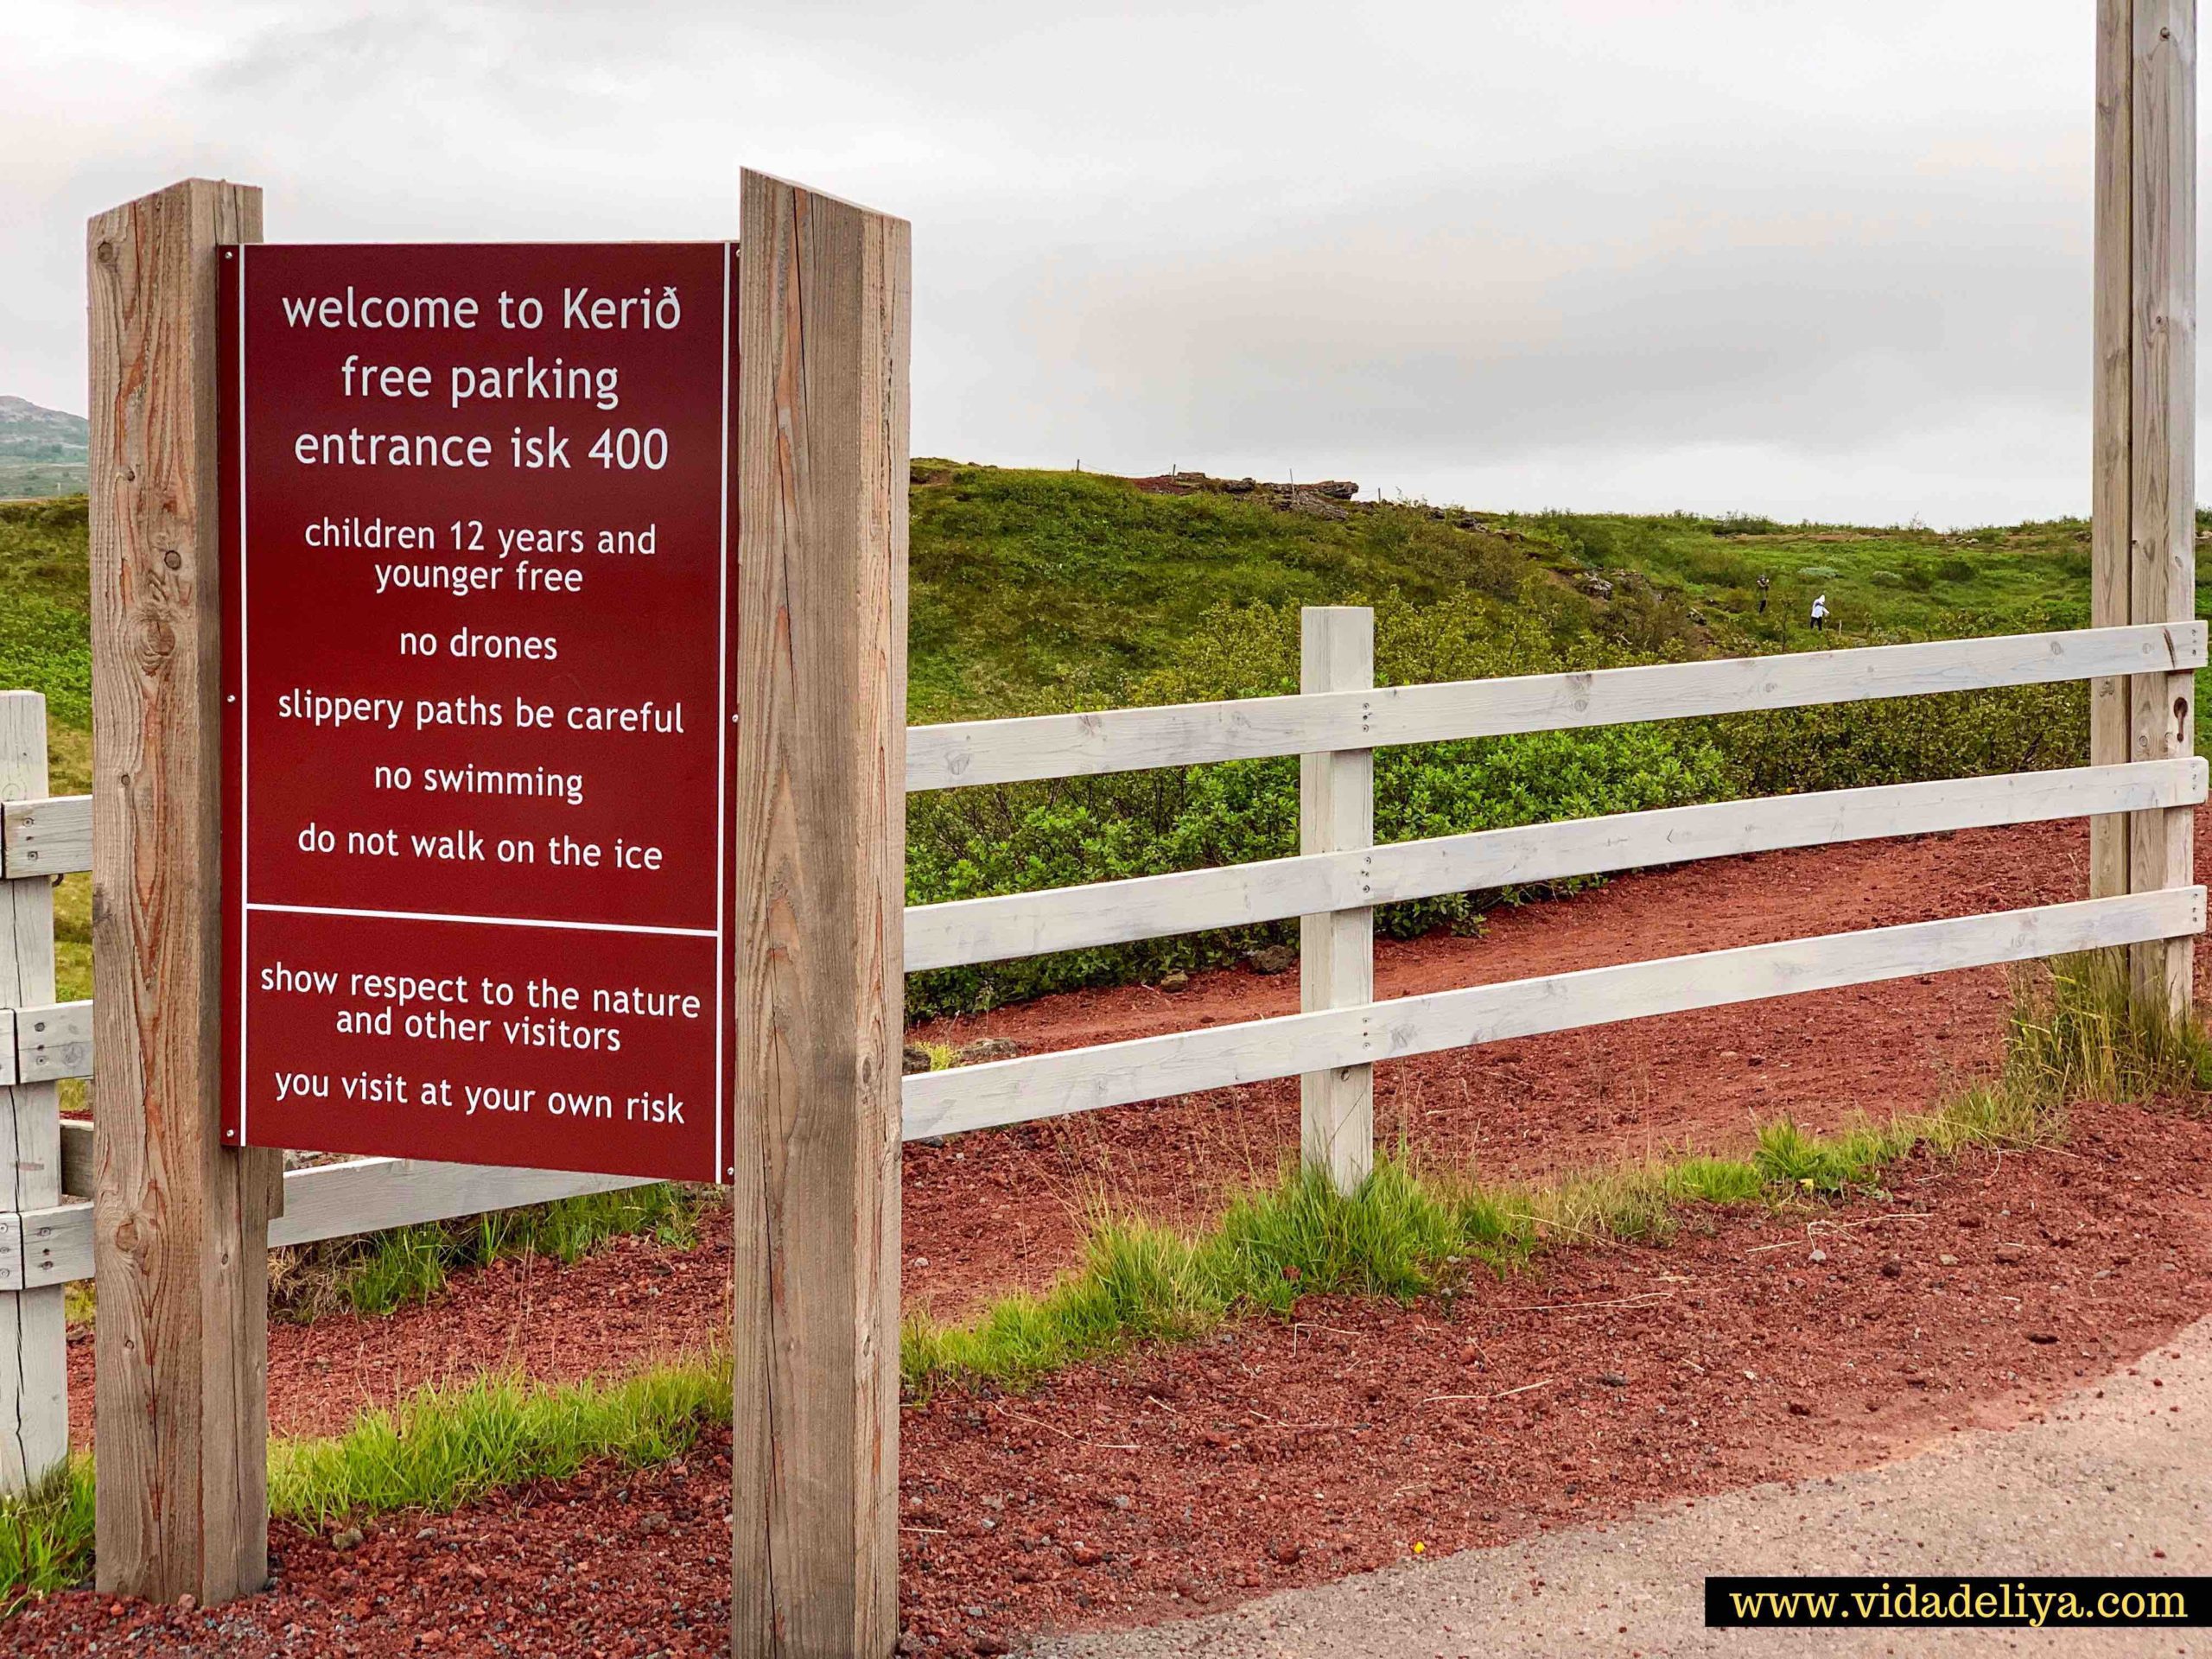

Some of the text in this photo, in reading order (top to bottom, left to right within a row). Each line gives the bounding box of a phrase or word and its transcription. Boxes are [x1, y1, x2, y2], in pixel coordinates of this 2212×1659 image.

[282, 285, 681, 330] welcome to Kerið
[341, 354, 619, 410] free parking
[295, 425, 669, 470] entrance isk 400
[305, 516, 656, 559] children 12 years and
[374, 560, 583, 597] younger free
[400, 626, 558, 660] no drones
[278, 688, 684, 734] slippery paths be careful
[375, 763, 583, 805] no swimming
[298, 822, 663, 870] do not walk on the ice
[261, 961, 701, 1019] show respect to the nature
[336, 1005, 621, 1052] and other visitors
[275, 1071, 685, 1124] you visit at your own risk
